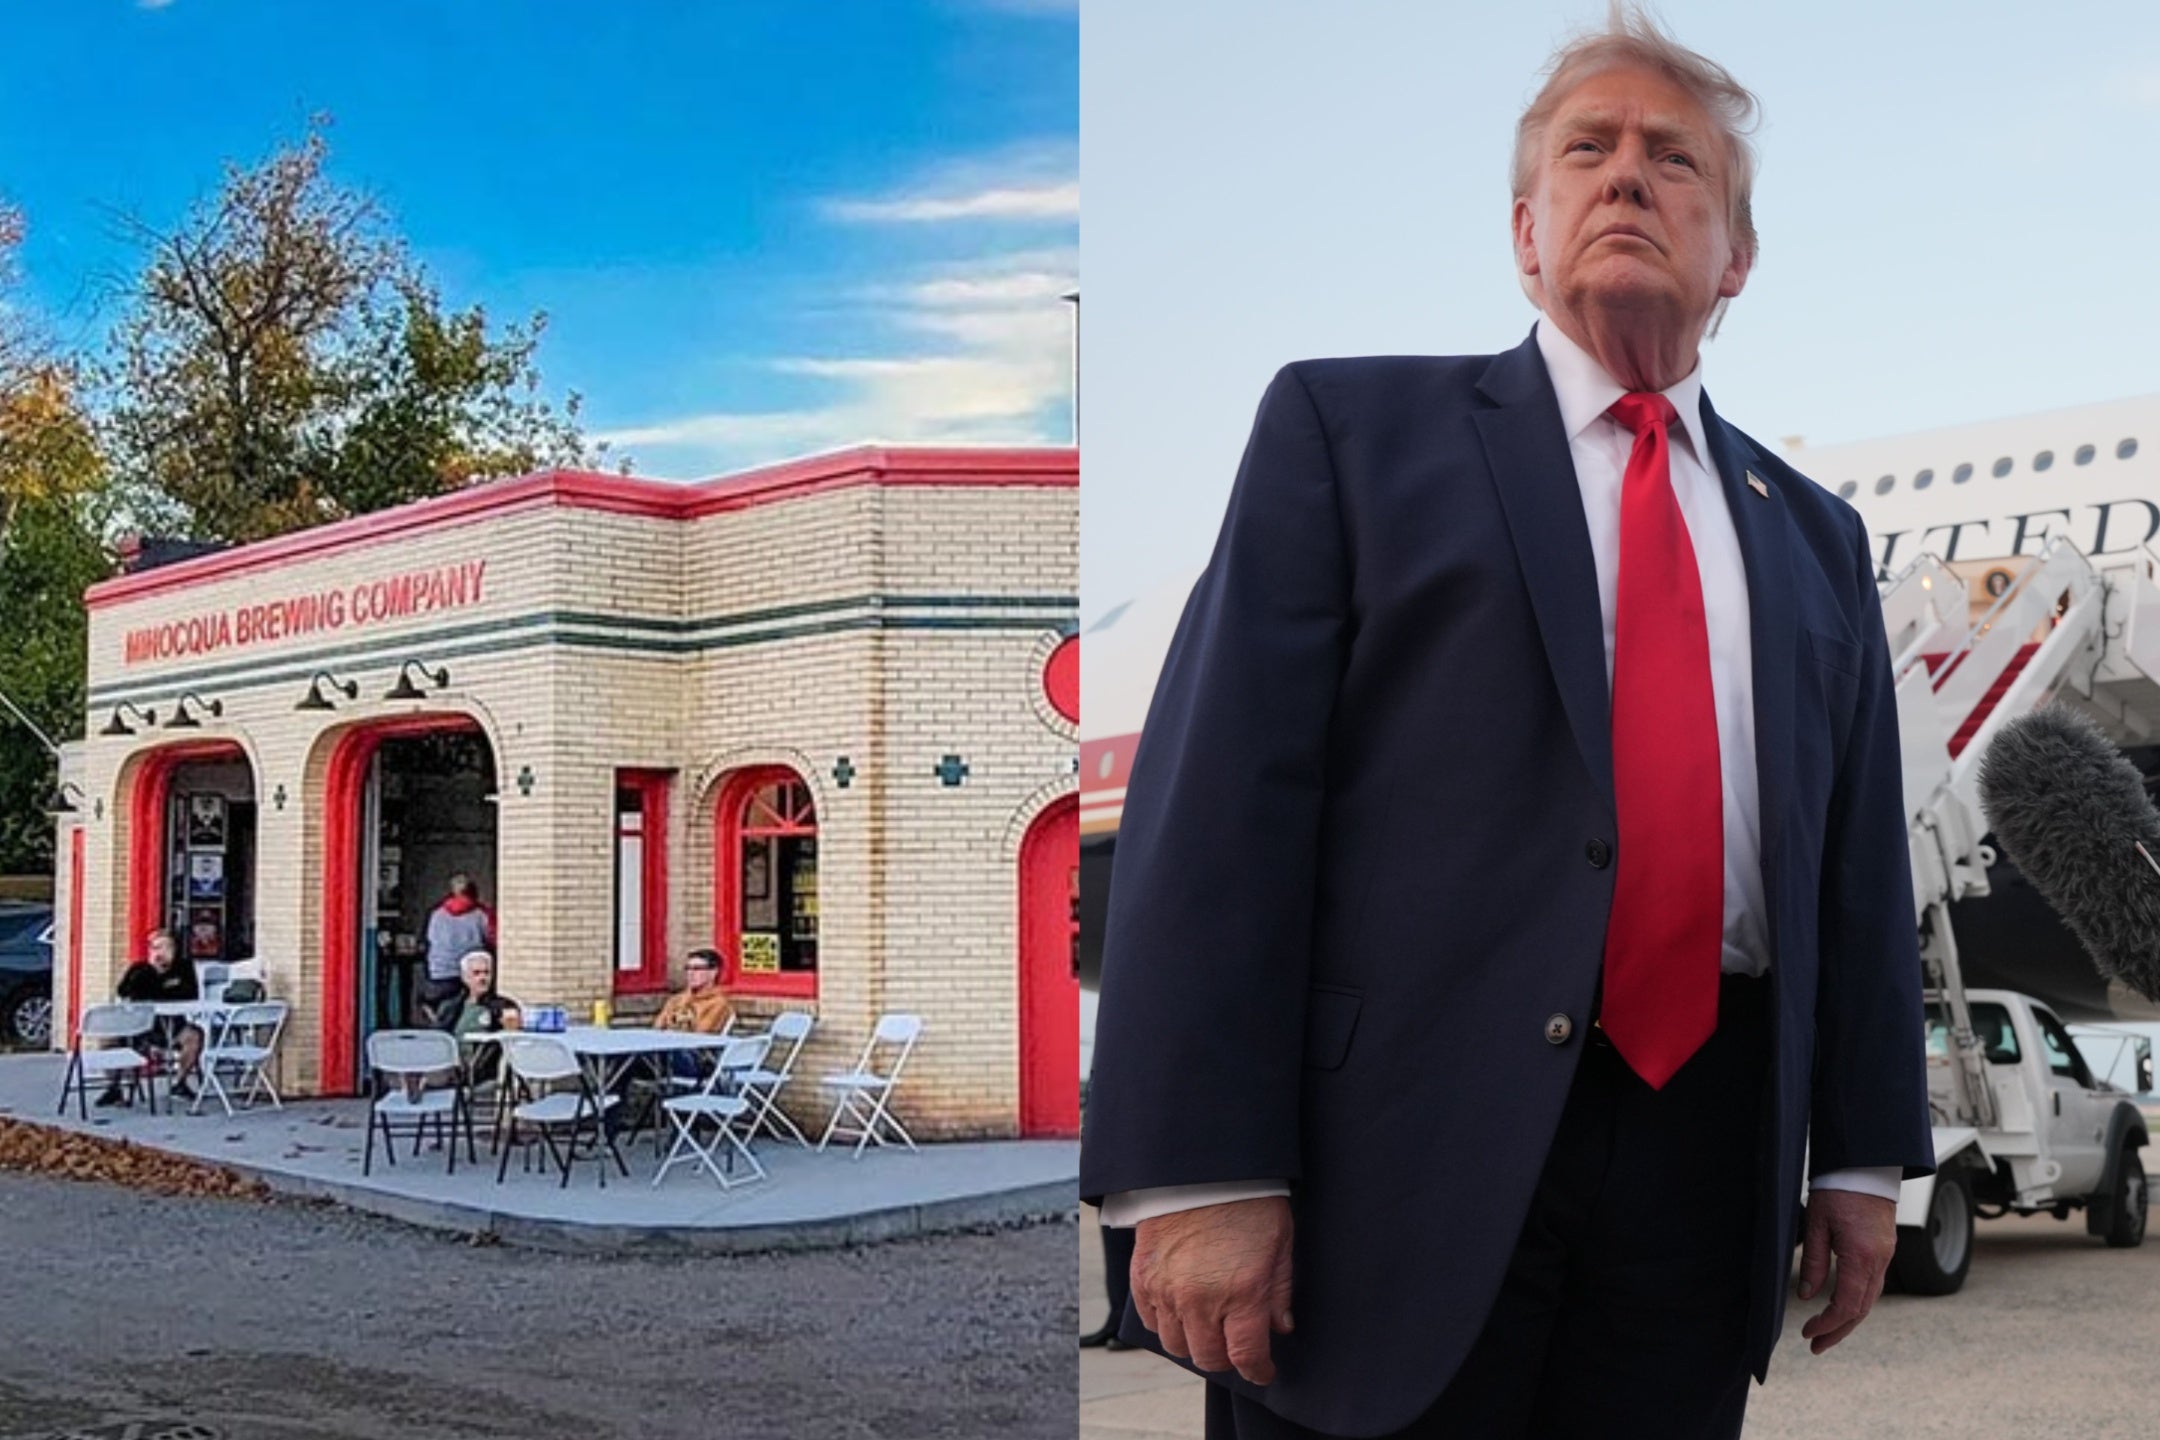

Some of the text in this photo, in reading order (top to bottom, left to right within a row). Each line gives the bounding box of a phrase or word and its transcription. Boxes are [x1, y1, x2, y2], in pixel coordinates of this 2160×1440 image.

[1876, 498, 2160, 583] ITED
[236, 588, 345, 646] BREWING
[352, 560, 486, 623] COMPANY
